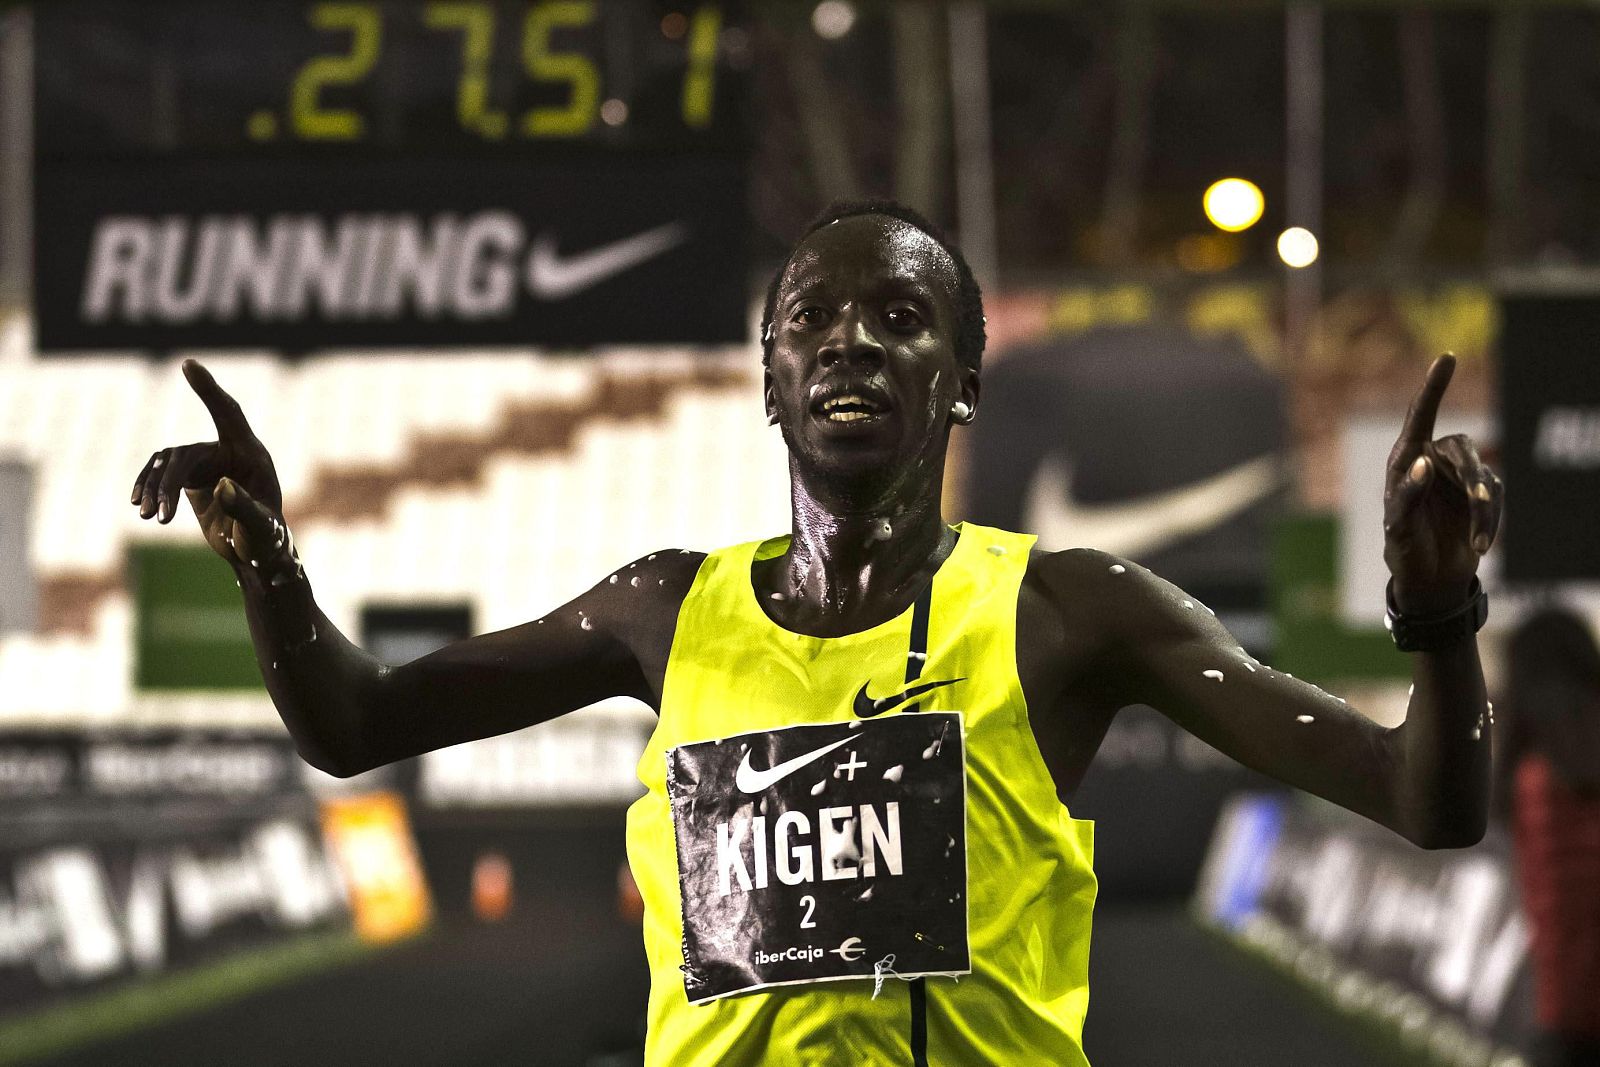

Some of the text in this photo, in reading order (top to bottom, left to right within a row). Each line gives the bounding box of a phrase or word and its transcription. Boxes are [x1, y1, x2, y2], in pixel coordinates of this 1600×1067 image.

[83, 210, 522, 321] RUNNING
[716, 802, 904, 896] KIGEN
[799, 895, 817, 929] 2
[754, 944, 824, 965] iberCaja
